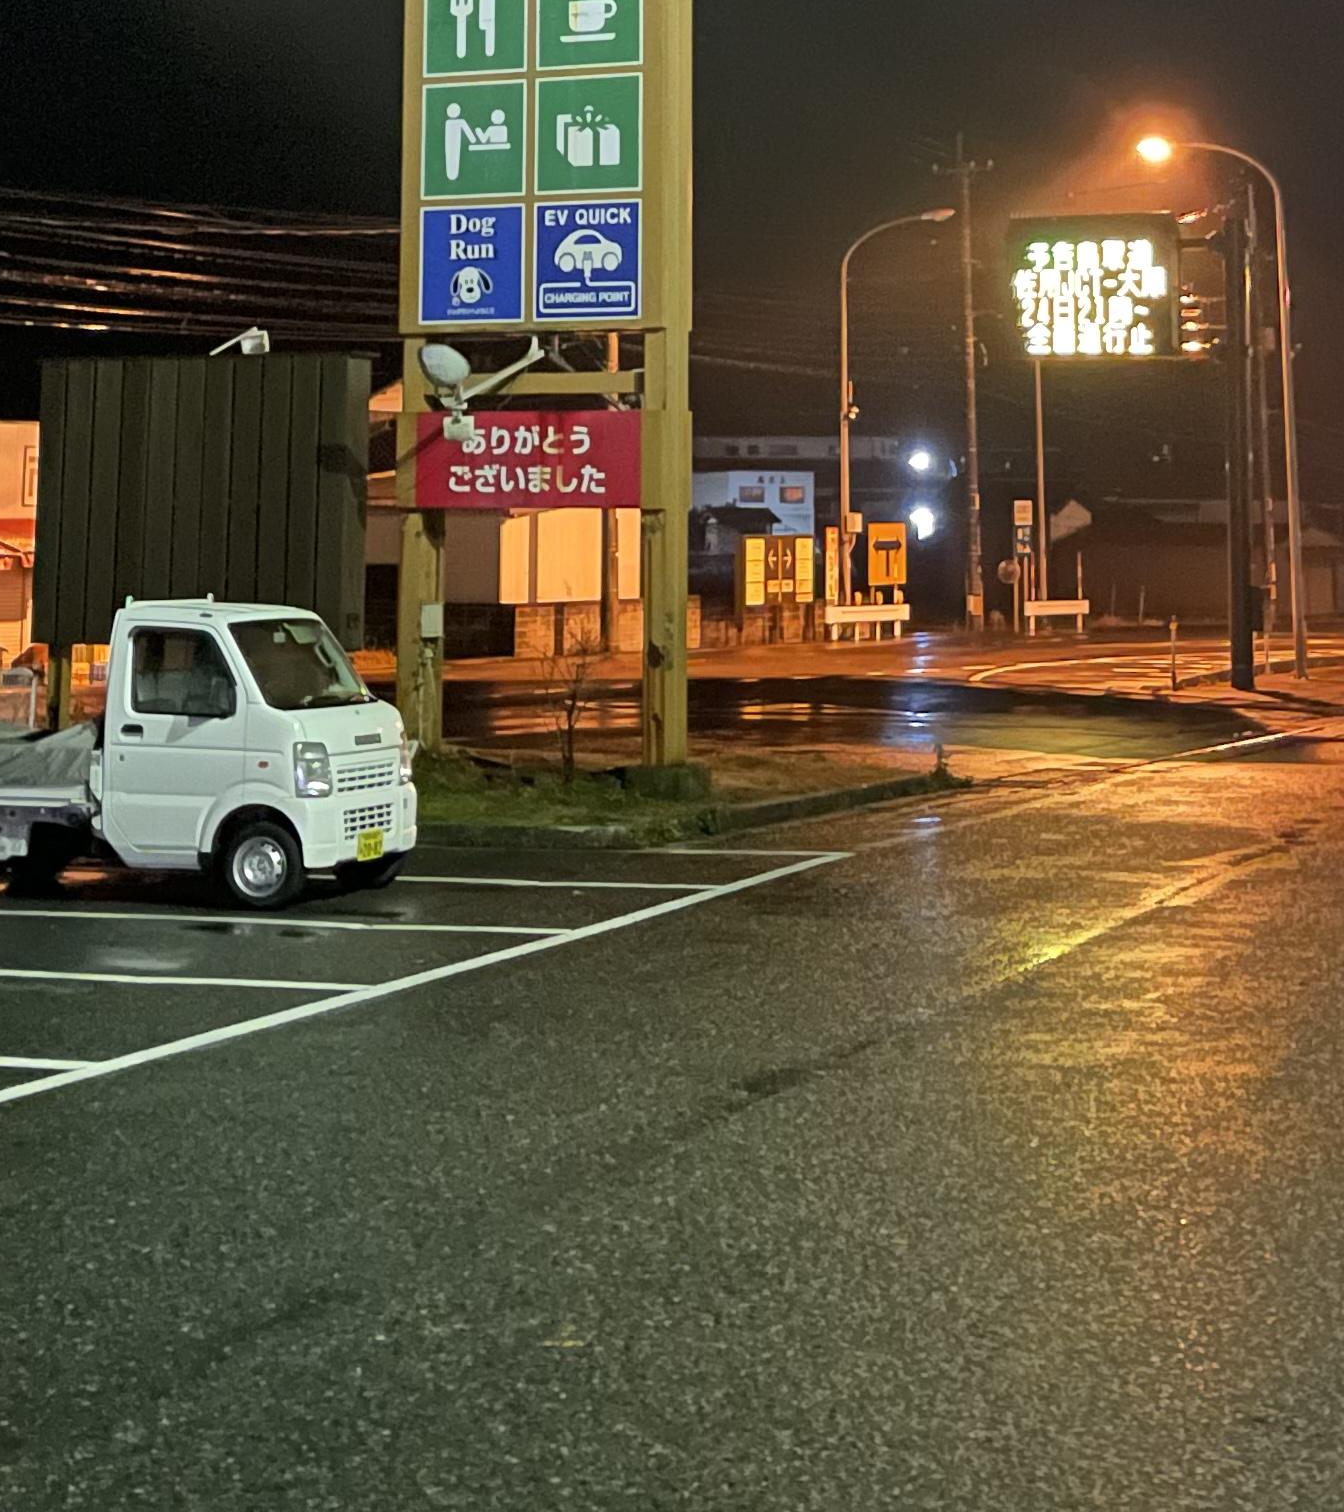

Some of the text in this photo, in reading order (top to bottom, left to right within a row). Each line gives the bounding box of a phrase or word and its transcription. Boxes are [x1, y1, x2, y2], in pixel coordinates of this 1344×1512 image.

[449, 213, 496, 236] Dog
[544, 207, 632, 226] EV QUICK
[449, 238, 495, 260] Run
[544, 291, 631, 304] CHARGING POINT
[448, 463, 606, 493] ございました
